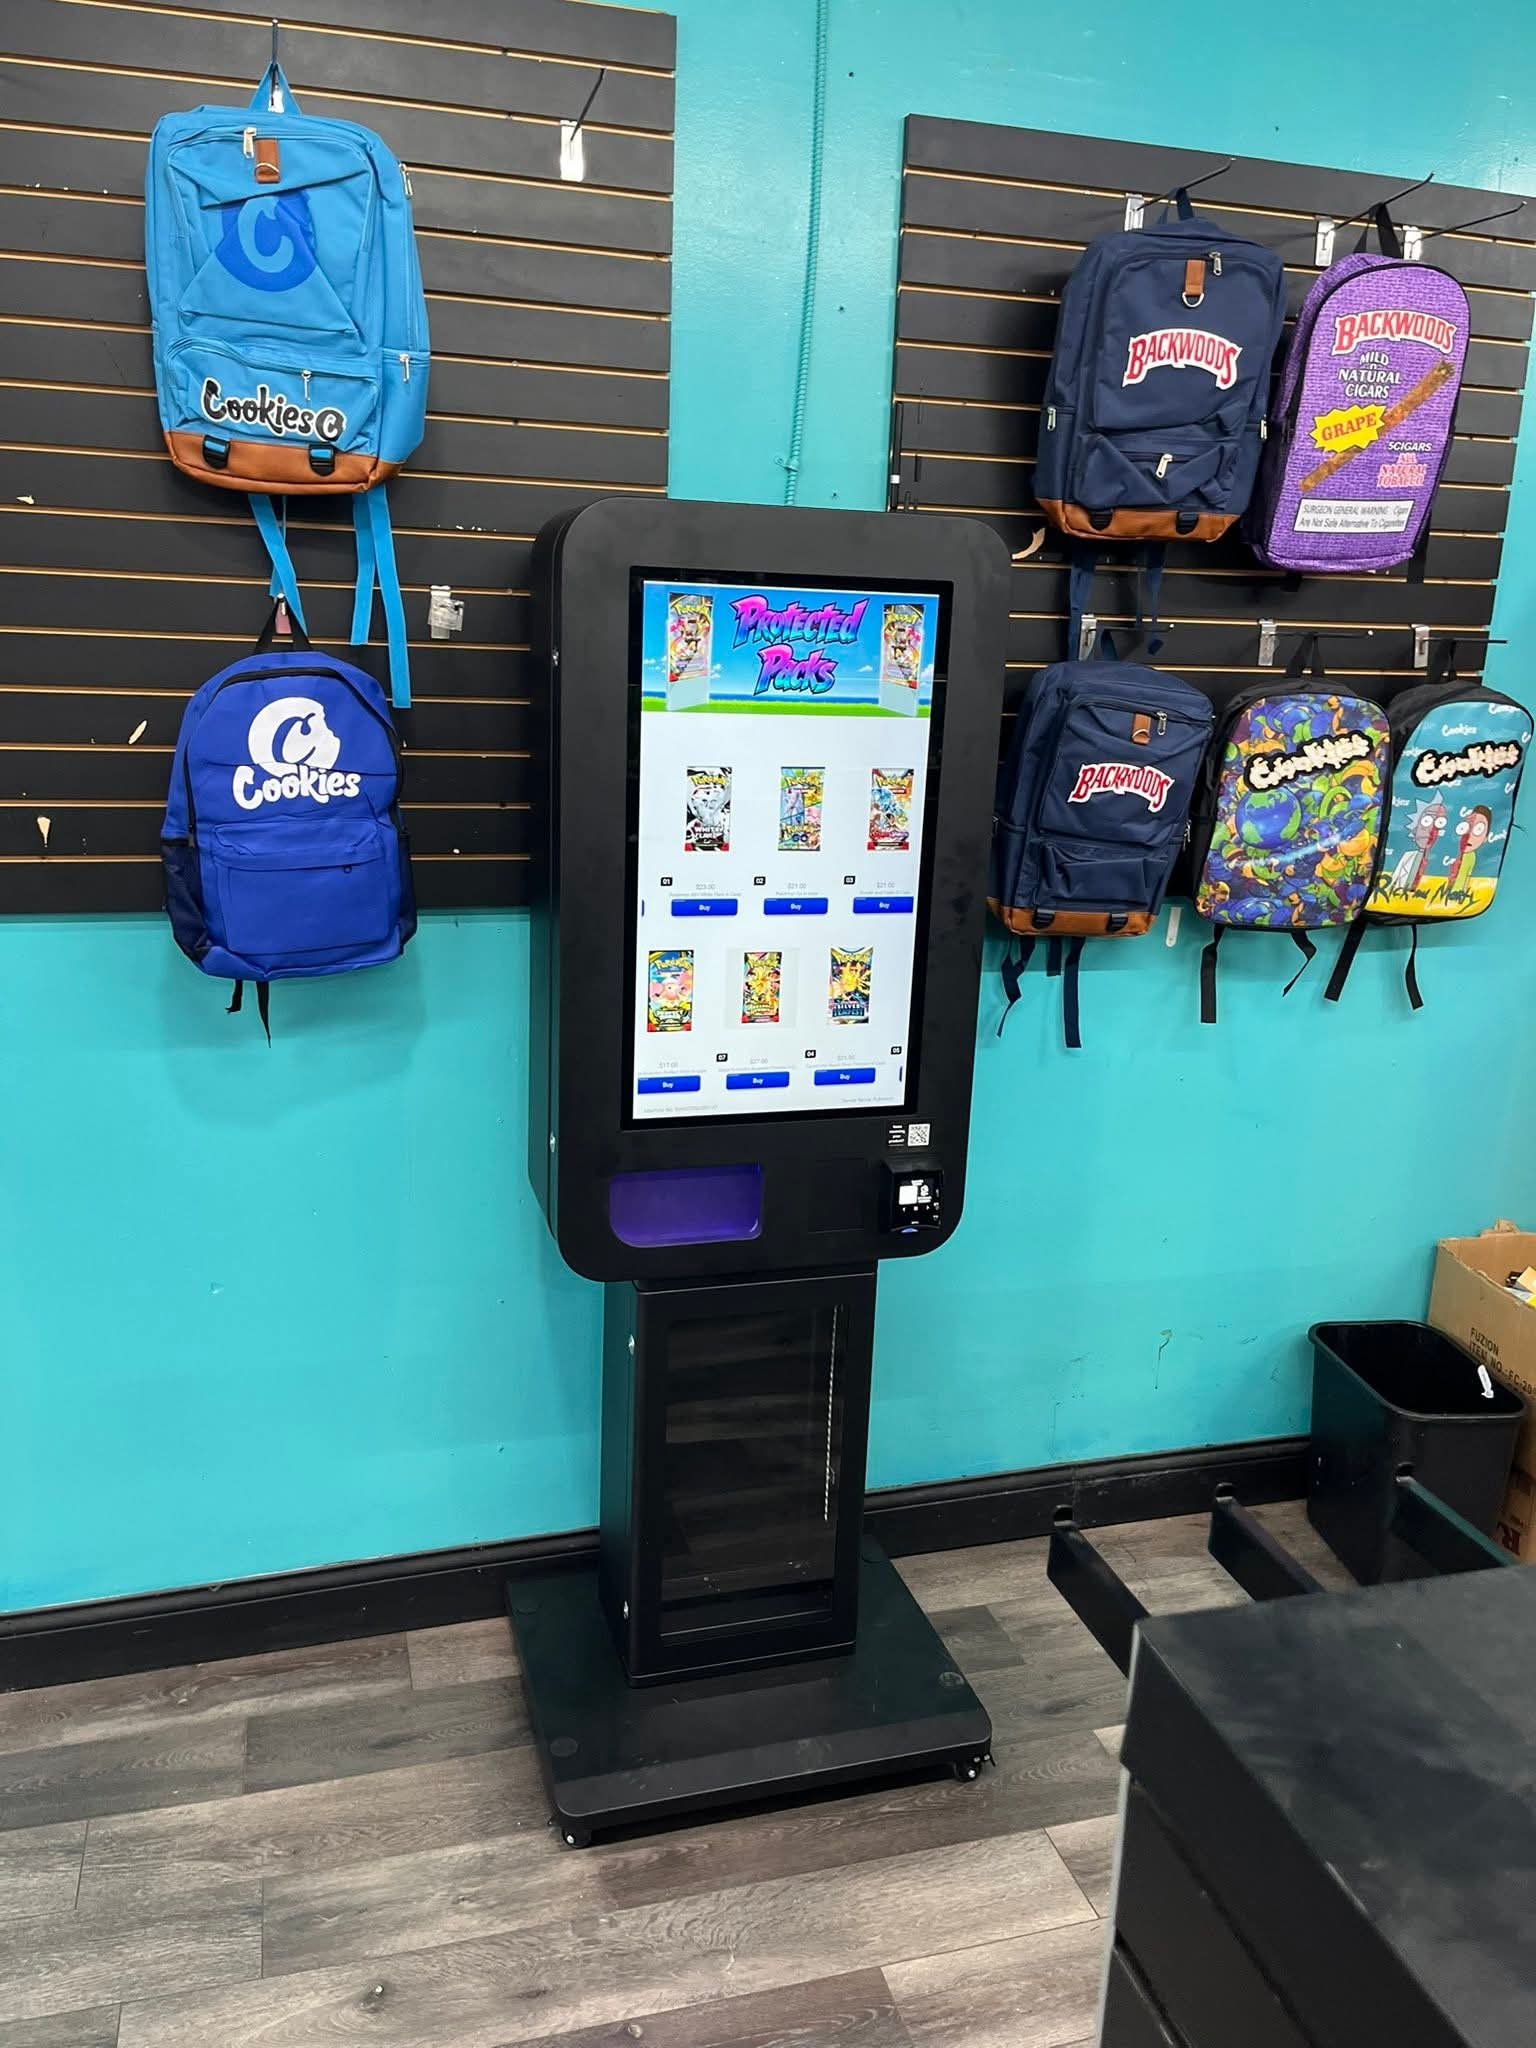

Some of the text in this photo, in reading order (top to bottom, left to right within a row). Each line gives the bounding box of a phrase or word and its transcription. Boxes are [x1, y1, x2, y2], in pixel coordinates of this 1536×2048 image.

[1332, 310, 1457, 355] BACKWOODS
[1123, 328, 1241, 389] BACKWOODS
[1360, 352, 1389, 366] MILD
[1338, 368, 1401, 384] NATURAL
[1345, 384, 1389, 399] CIGARS
[201, 378, 315, 436] Cookies
[1321, 412, 1377, 441] GRAPE
[1381, 464, 1427, 475] NATURAL
[1377, 476, 1425, 487] TOBACCO
[1303, 504, 1332, 514] SURGEON
[1333, 505, 1359, 515] GENERAL
[1247, 733, 1371, 790] Cookies
[1414, 742, 1520, 786] Cookies
[232, 765, 361, 809] Cookies
[1067, 763, 1175, 812] BACKWOODS
[698, 904, 711, 912] Buy
[790, 903, 802, 911] Buy
[752, 1077, 763, 1085] Buy
[839, 1073, 850, 1081] Buy
[662, 1081, 673, 1089] Buy
[1470, 1327, 1499, 1356] FUZION
